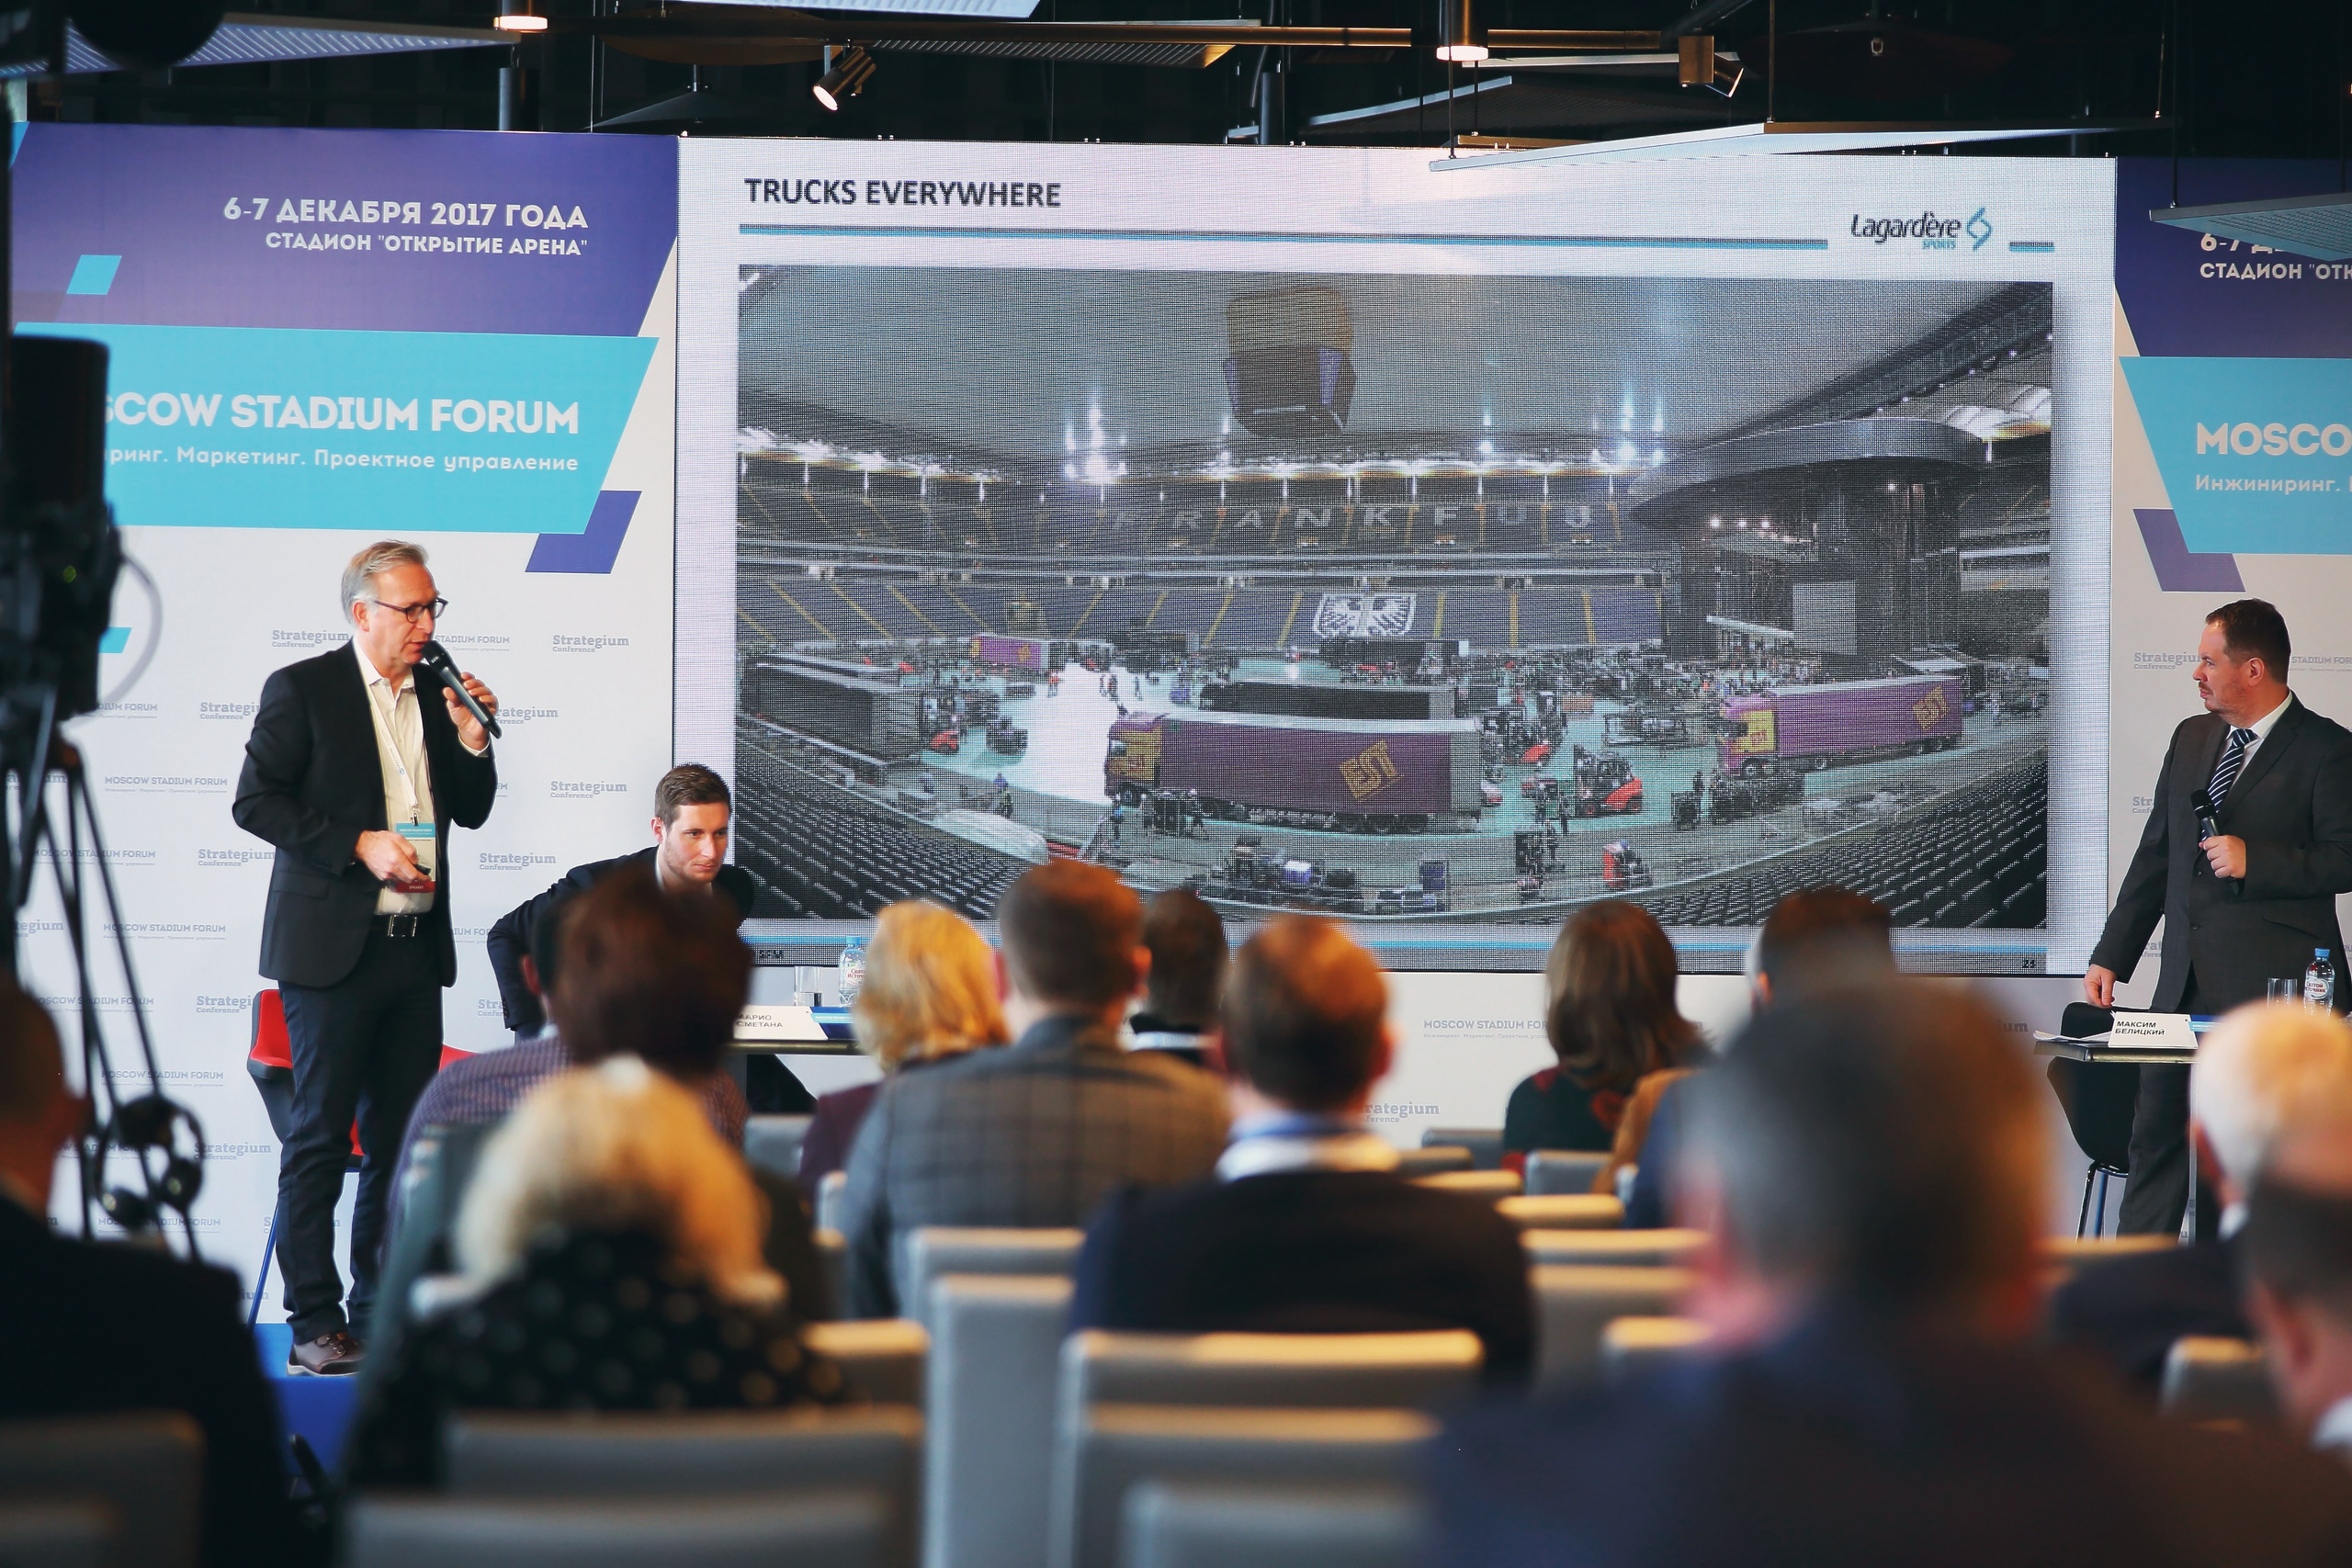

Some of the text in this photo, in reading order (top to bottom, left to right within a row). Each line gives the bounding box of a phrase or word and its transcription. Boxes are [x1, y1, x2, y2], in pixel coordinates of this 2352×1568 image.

[744, 177, 1061, 209] TRUCKS EVERYWHERE
[223, 197, 589, 230] 6-7 ДЕКАБРЯ 2017 ГОДА
[1851, 211, 1962, 244] Lagardère
[266, 231, 588, 256] СТАДИОН "ОТКРЫТИЕ АРЕНА"
[2199, 263, 2302, 280] СТАДИОН
[106, 392, 579, 434] COW STADIUM FORUM
[2197, 423, 2352, 457] MOSCO
[177, 446, 306, 468] Маркетинг.
[314, 449, 435, 472] Проектное
[445, 455, 579, 474] управление
[2196, 475, 2341, 495] Инжиниринг.
[272, 629, 349, 644] Strategium
[435, 635, 510, 645] STADIUM FORUM
[552, 634, 629, 649] Strategium
[2133, 651, 2201, 666] Strategiu
[2292, 656, 2331, 664] STADIUM
[124, 703, 158, 712] FORUM
[200, 701, 260, 716] Strategi
[496, 706, 559, 721] rategium
[105, 776, 228, 785] MOSCOW STADIUM FORUM
[550, 780, 628, 795] Strategium
[123, 850, 155, 859] FORUM
[198, 849, 275, 863] Strategium
[480, 852, 556, 866] Strategium
[150, 924, 190, 932] STADIUM
[193, 924, 226, 932] FORUM
[197, 996, 253, 1010] Strategi
[1423, 1020, 1475, 1029] MOSCOW
[1476, 1020, 1524, 1030] STADIUM
[2115, 1028, 2165, 1036] БЕЛИЦКИЙ
[2116, 1021, 2157, 1029] МАКСИМ
[191, 1071, 223, 1079] FORUM
[1364, 1101, 1440, 1118] rategium
